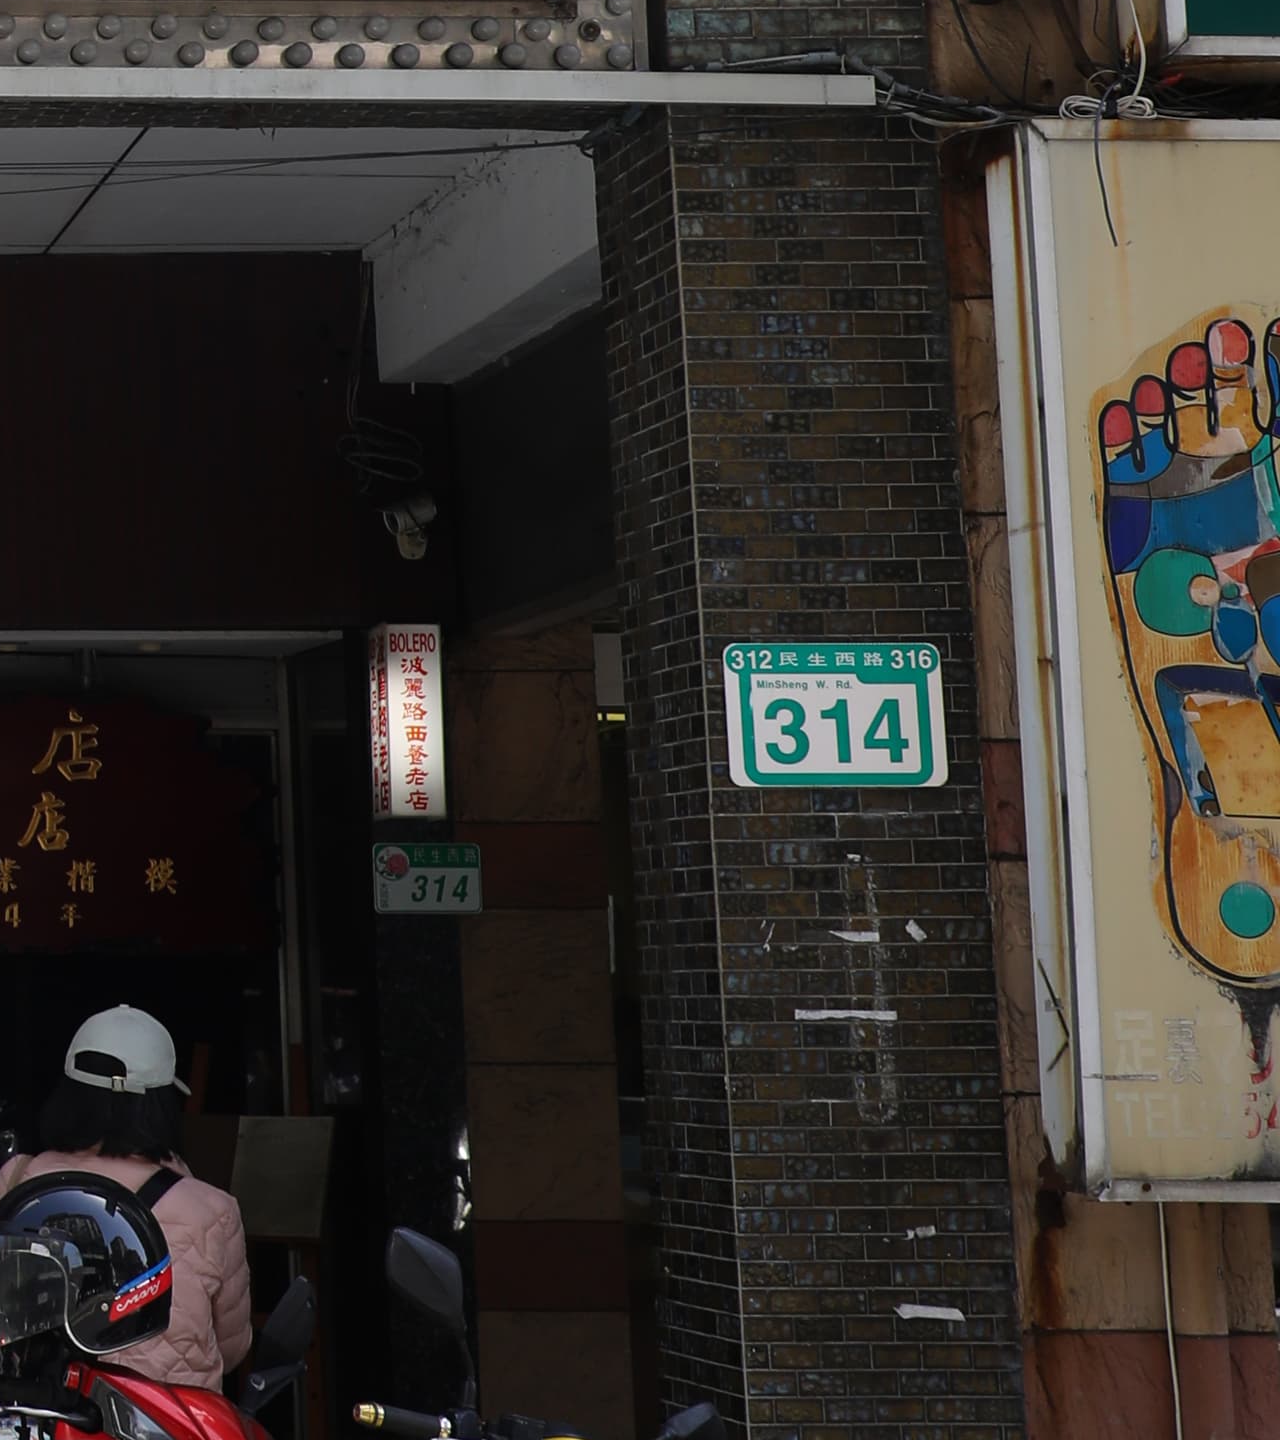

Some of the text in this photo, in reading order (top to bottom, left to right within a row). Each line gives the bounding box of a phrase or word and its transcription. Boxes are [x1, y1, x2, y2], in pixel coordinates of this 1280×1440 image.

[389, 633, 436, 653] BOLERO
[731, 649, 933, 669] 312 民生西路 316
[756, 680, 853, 691] MinSheng W. Rd.
[764, 698, 910, 765] 314
[411, 875, 468, 903] 314
